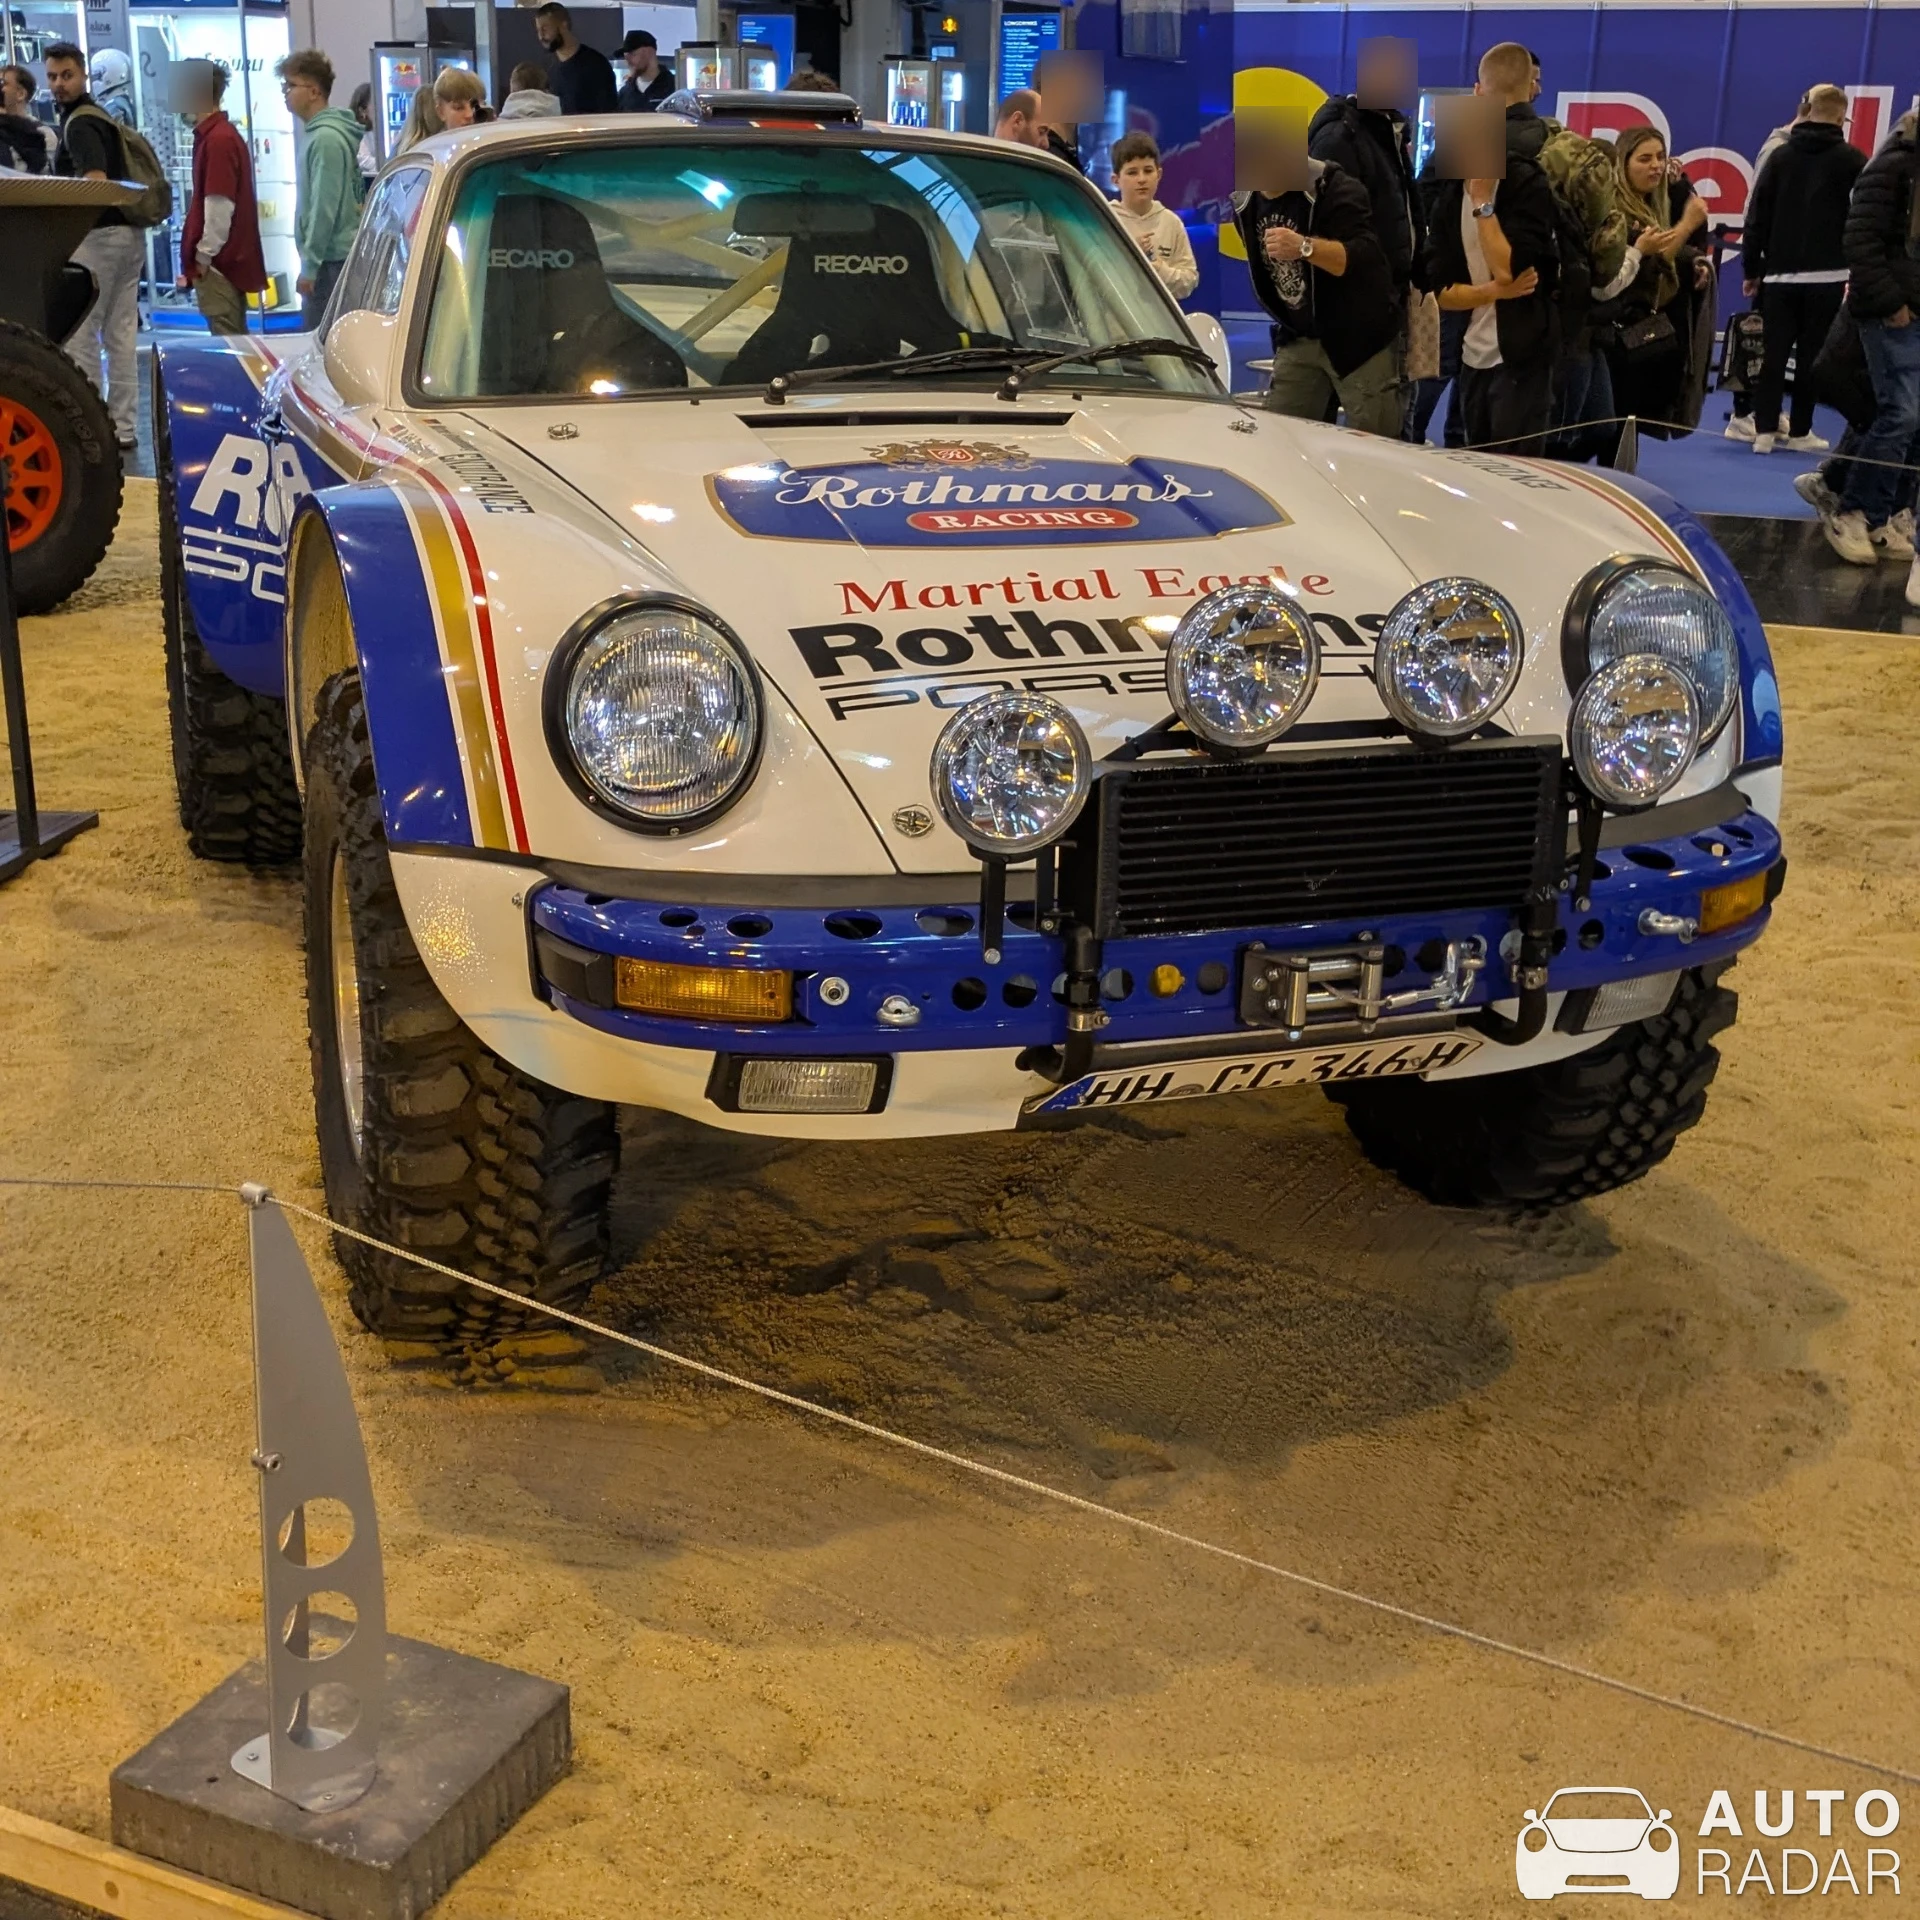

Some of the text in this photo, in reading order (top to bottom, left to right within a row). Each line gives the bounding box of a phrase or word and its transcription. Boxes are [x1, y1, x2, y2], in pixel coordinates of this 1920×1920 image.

[814, 254, 909, 275] RECARO
[775, 470, 1214, 511] Rothmans
[930, 510, 1117, 530] RACING
[834, 569, 1121, 617] Martial
[1085, 1072, 1175, 1106] HH
[1204, 1059, 1295, 1094] CC
